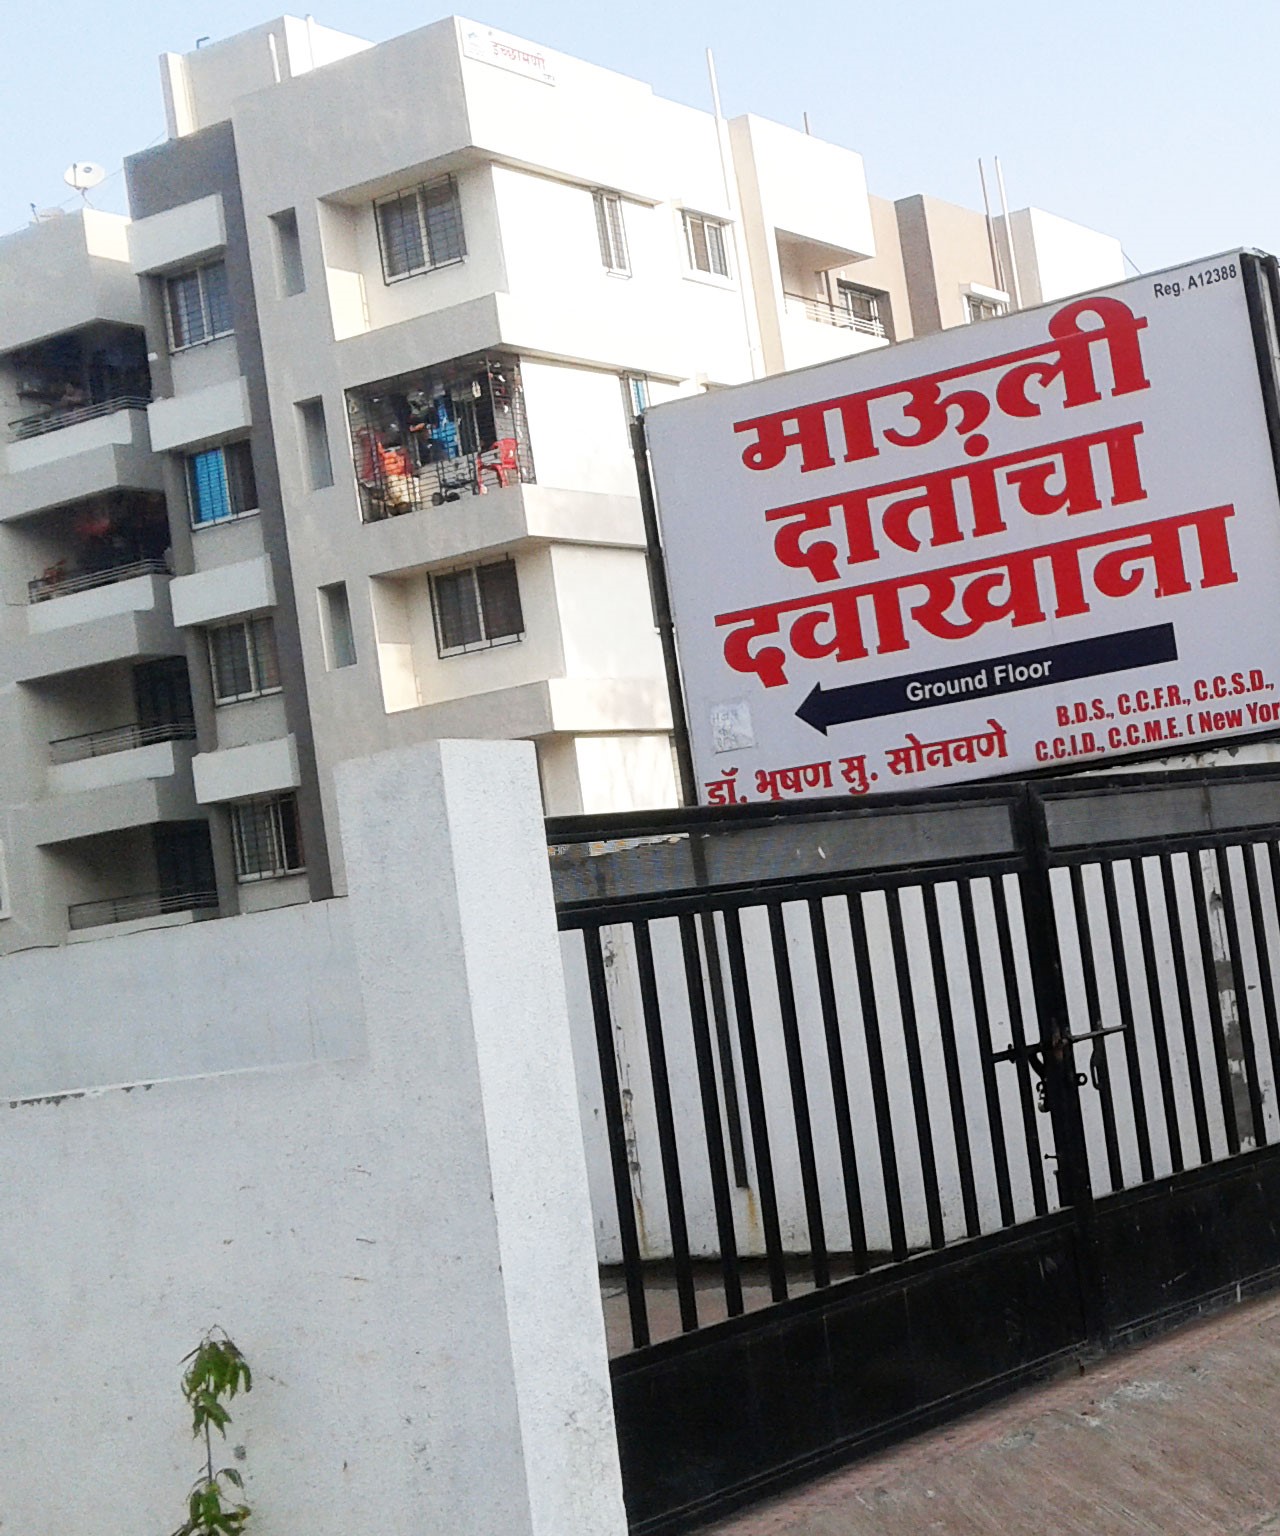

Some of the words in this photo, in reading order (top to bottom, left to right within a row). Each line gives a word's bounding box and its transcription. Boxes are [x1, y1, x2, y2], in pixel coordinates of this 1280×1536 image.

[1153, 282, 1185, 298] Reg.
[1188, 264, 1237, 290] A12388
[733, 296, 1151, 473] माऊली
[764, 421, 1148, 583] दातांचा
[714, 503, 1239, 689] दवाखाना
[906, 669, 988, 702] Ground
[993, 660, 1053, 686] Floor
[1056, 699, 1115, 727] B.D.S.,
[1108, 717, 1184, 749] C.C.M.E.
[1198, 708, 1243, 734] New
[704, 767, 748, 806] डॉ.
[838, 754, 879, 795] सु.
[884, 718, 1009, 776] सोनवणे
